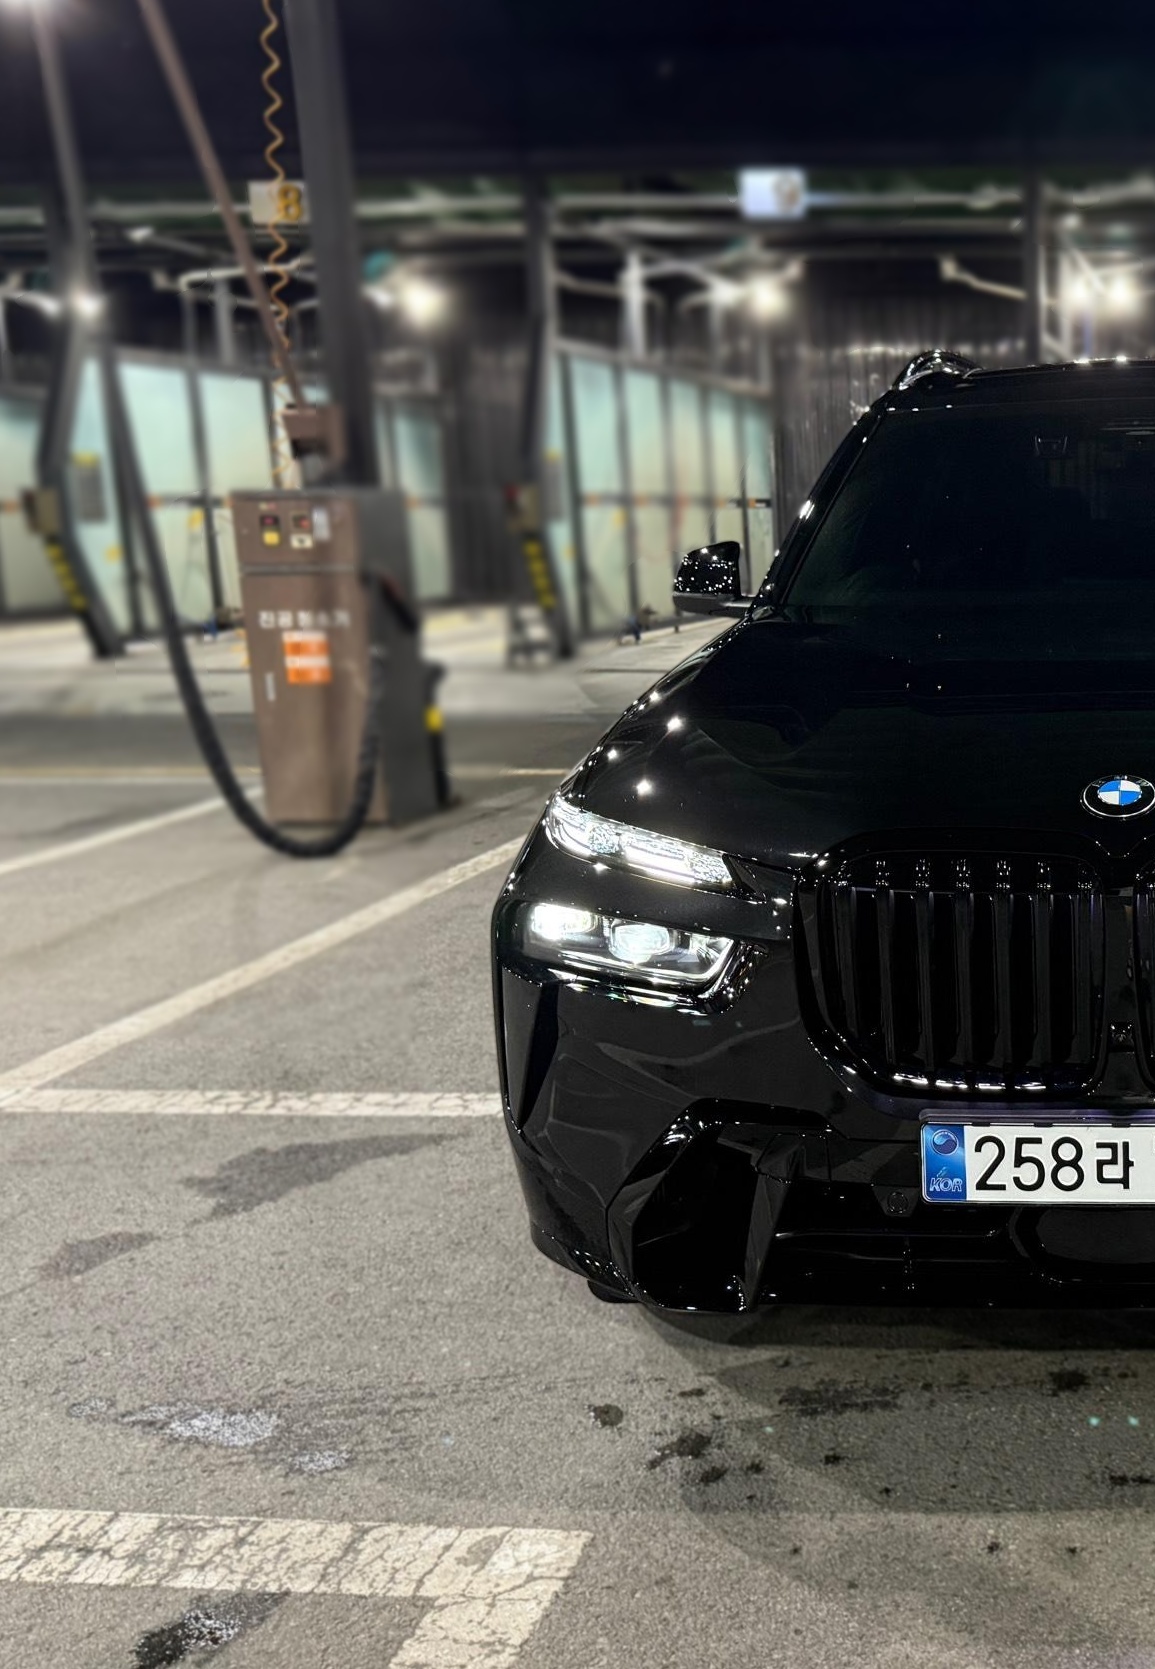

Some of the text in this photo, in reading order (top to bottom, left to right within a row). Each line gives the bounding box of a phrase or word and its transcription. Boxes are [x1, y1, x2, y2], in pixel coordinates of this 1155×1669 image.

[278, 183, 303, 221] 8
[974, 1135, 1134, 1192] 258라
[929, 1177, 963, 1192] KOR
